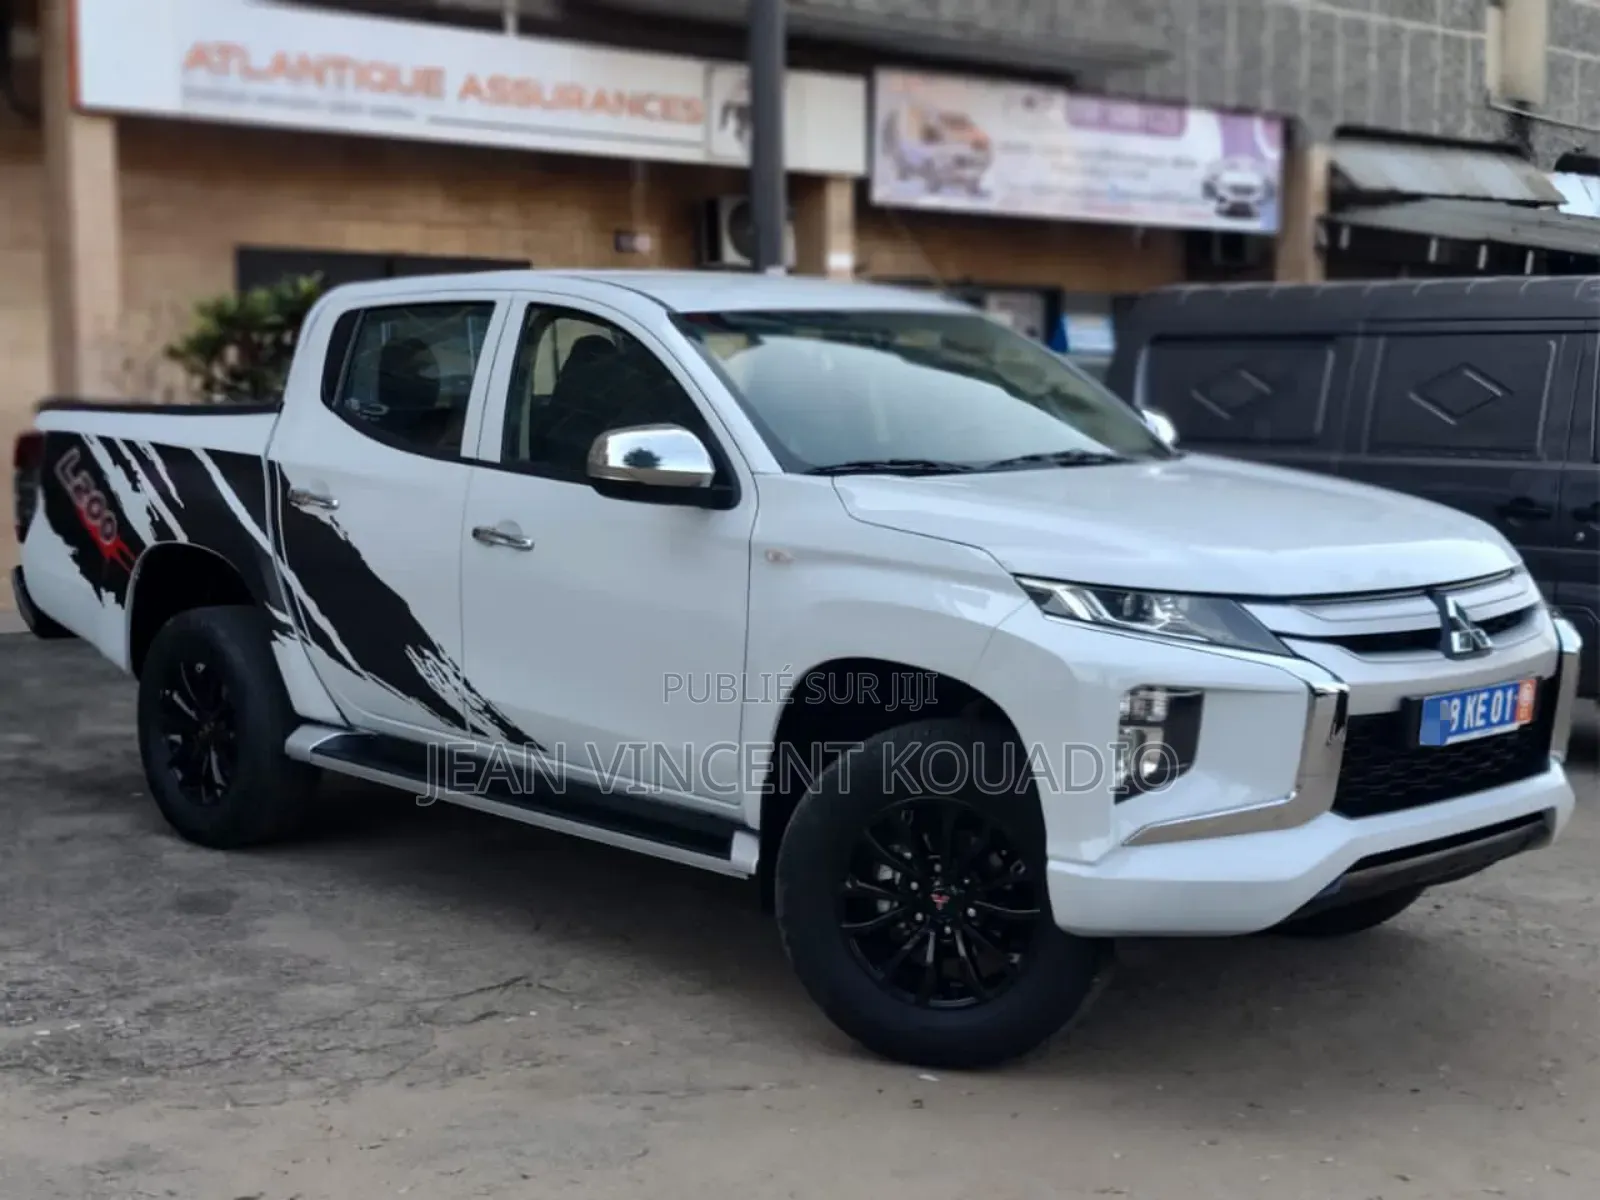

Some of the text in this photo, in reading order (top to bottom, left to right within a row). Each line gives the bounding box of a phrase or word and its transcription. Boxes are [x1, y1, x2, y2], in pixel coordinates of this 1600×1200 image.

[181, 40, 446, 102] ATLANTIQUE
[457, 72, 706, 126] ASSURANCES
[55, 447, 117, 544] L200
[1463, 691, 1489, 730] KE
[1490, 687, 1513, 724] 01
